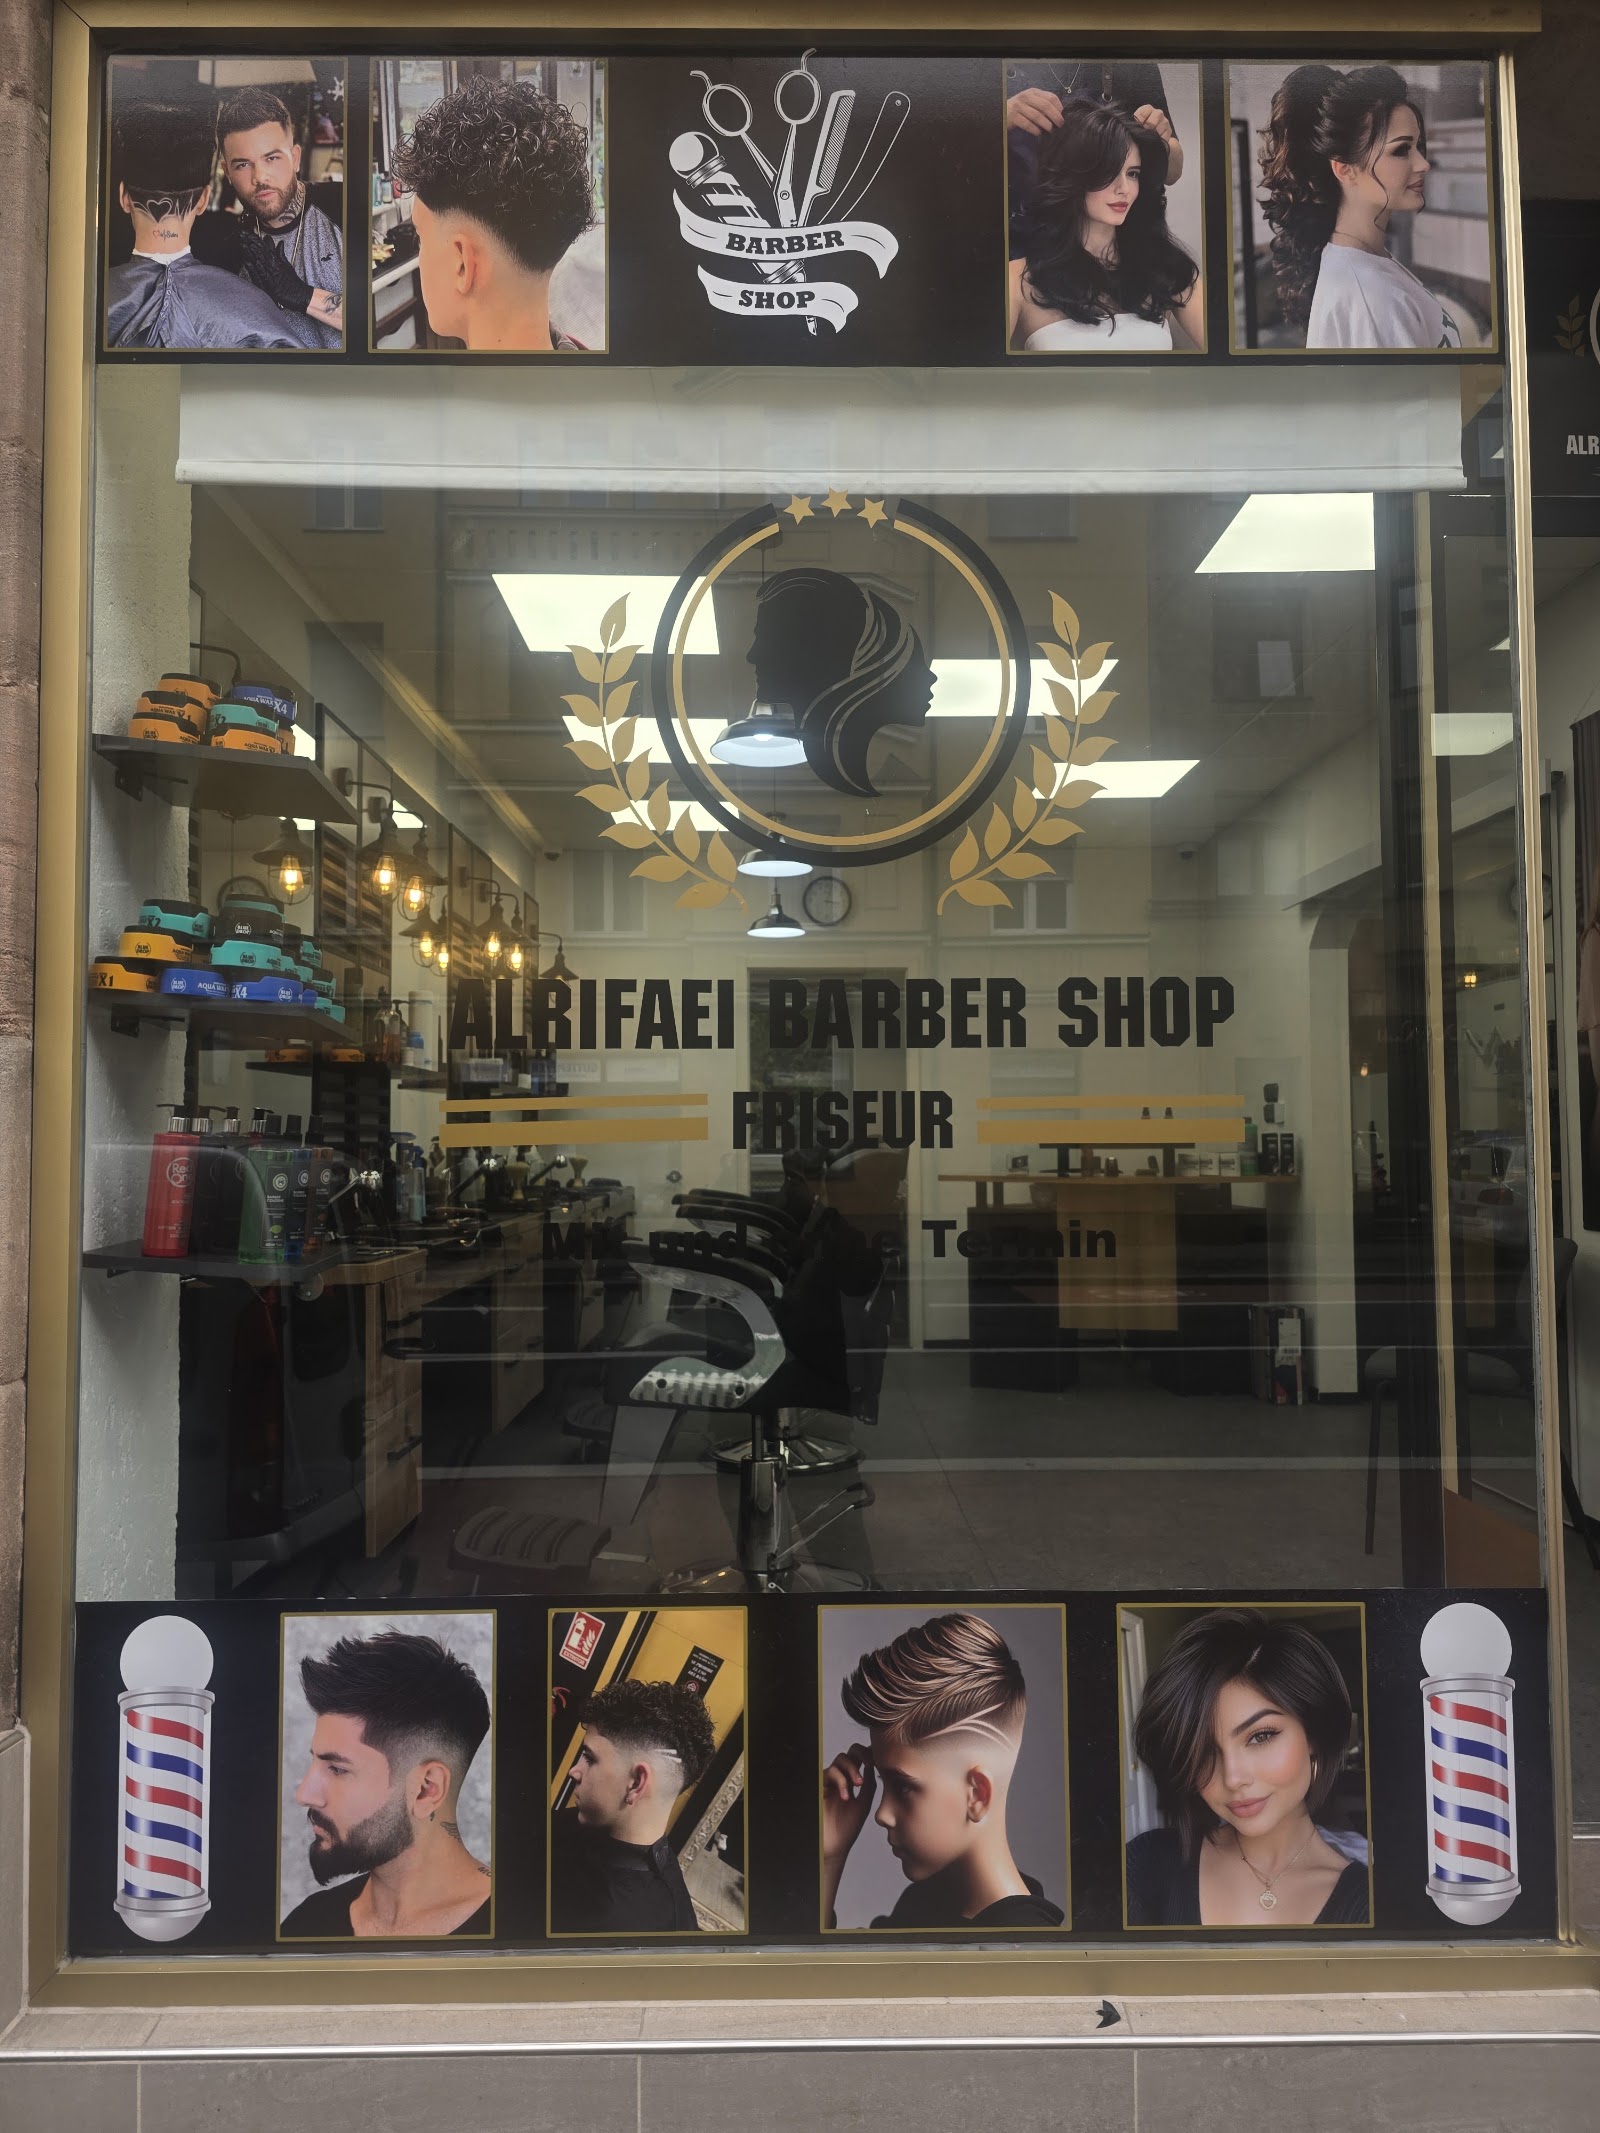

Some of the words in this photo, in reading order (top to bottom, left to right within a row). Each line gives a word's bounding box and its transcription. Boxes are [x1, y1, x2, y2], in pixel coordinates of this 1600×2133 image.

[726, 230, 844, 255] BARBER
[739, 289, 816, 310] SHOP
[1566, 435, 1600, 455] ALR
[273, 700, 288, 715] X4
[98, 975, 114, 987] X1
[197, 982, 216, 991] AQUA
[235, 985, 247, 998] X4
[449, 978, 735, 1050] ALRIFAEI
[769, 977, 1027, 1049] BARBER
[1058, 976, 1235, 1048] SHOP
[731, 1089, 954, 1150] FRISEUR
[172, 1162, 193, 1174] Red
[171, 1173, 192, 1184] On
[921, 1219, 1117, 1258] Termin
